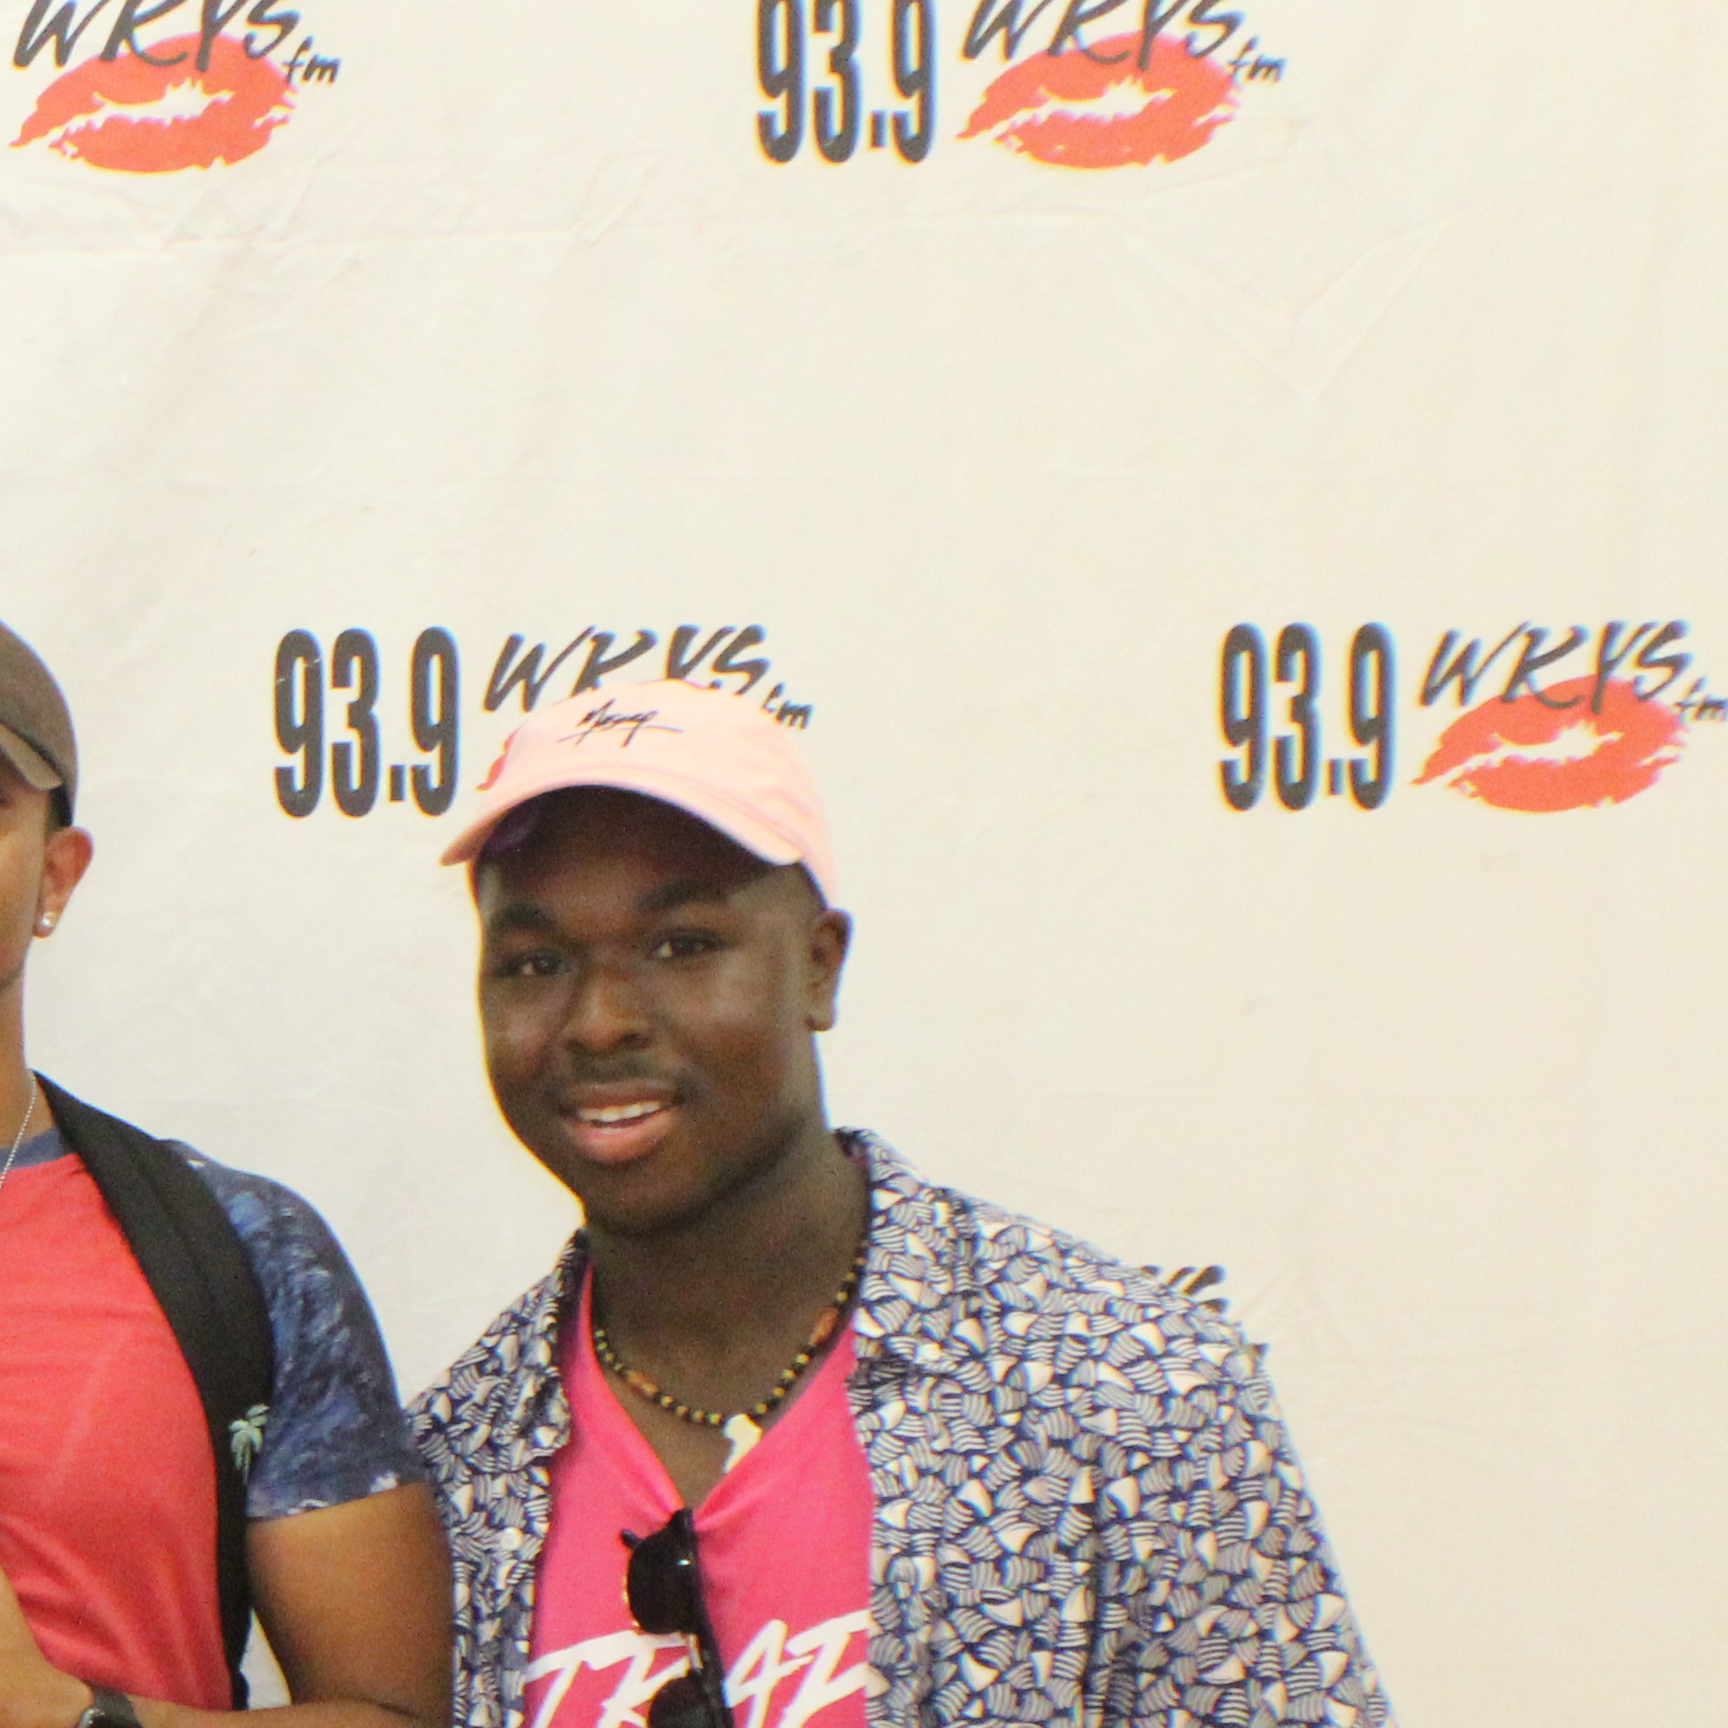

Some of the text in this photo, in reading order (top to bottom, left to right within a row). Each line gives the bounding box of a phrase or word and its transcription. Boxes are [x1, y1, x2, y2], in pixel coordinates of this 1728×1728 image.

[13, 0, 300, 73] WKYS
[757, 0, 937, 164] 93.9
[962, 0, 1244, 71] WKYS
[274, 626, 461, 818] 93.9
[1220, 622, 1397, 812] 93.9
[1420, 620, 1693, 715] WKYS
